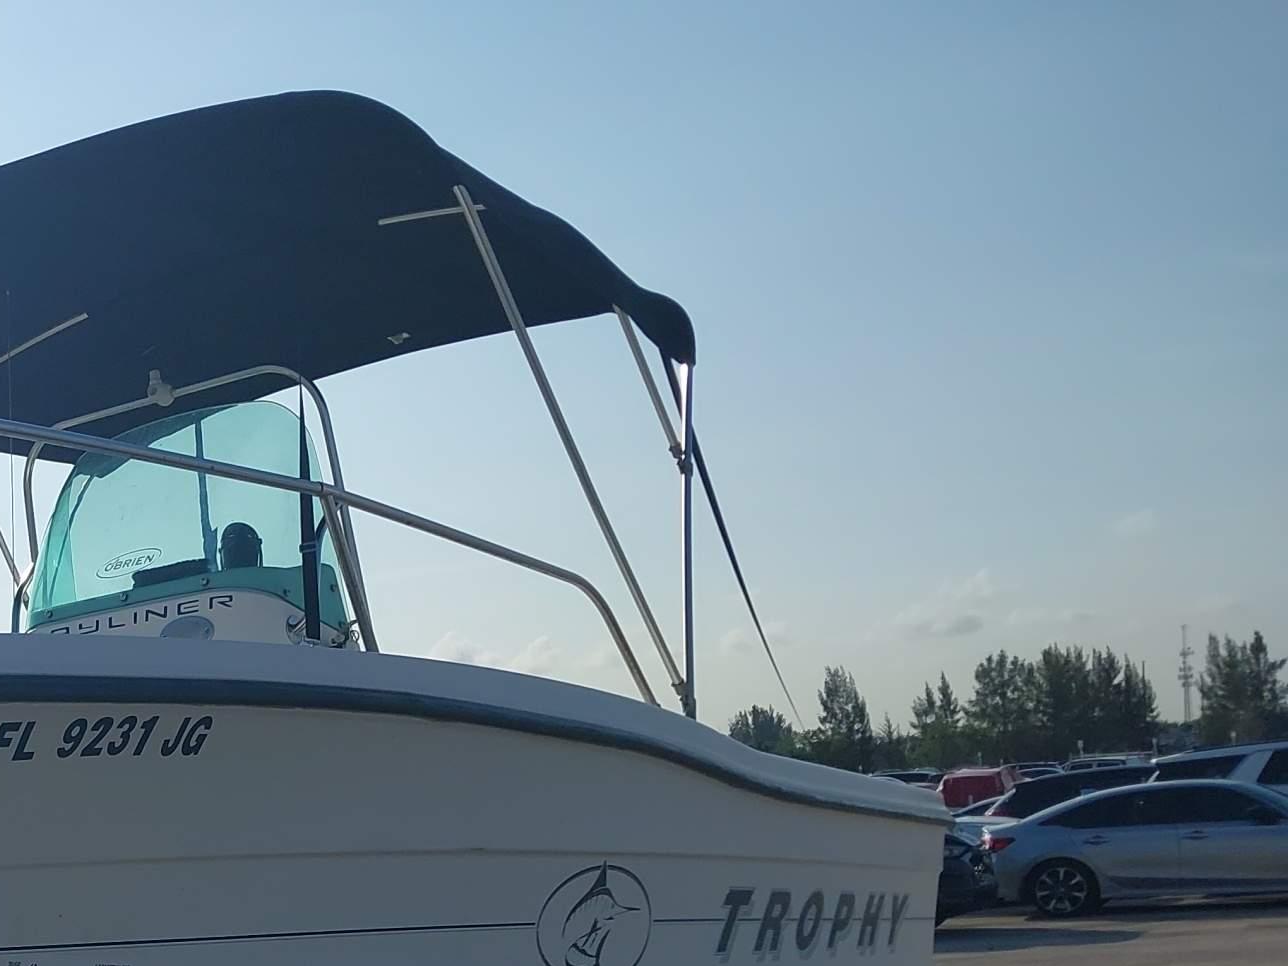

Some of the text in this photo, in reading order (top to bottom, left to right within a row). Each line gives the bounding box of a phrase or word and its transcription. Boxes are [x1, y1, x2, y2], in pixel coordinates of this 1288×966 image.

[56, 715, 160, 759] 9231
[160, 714, 213, 758] JG
[715, 886, 910, 962] TROPHY
